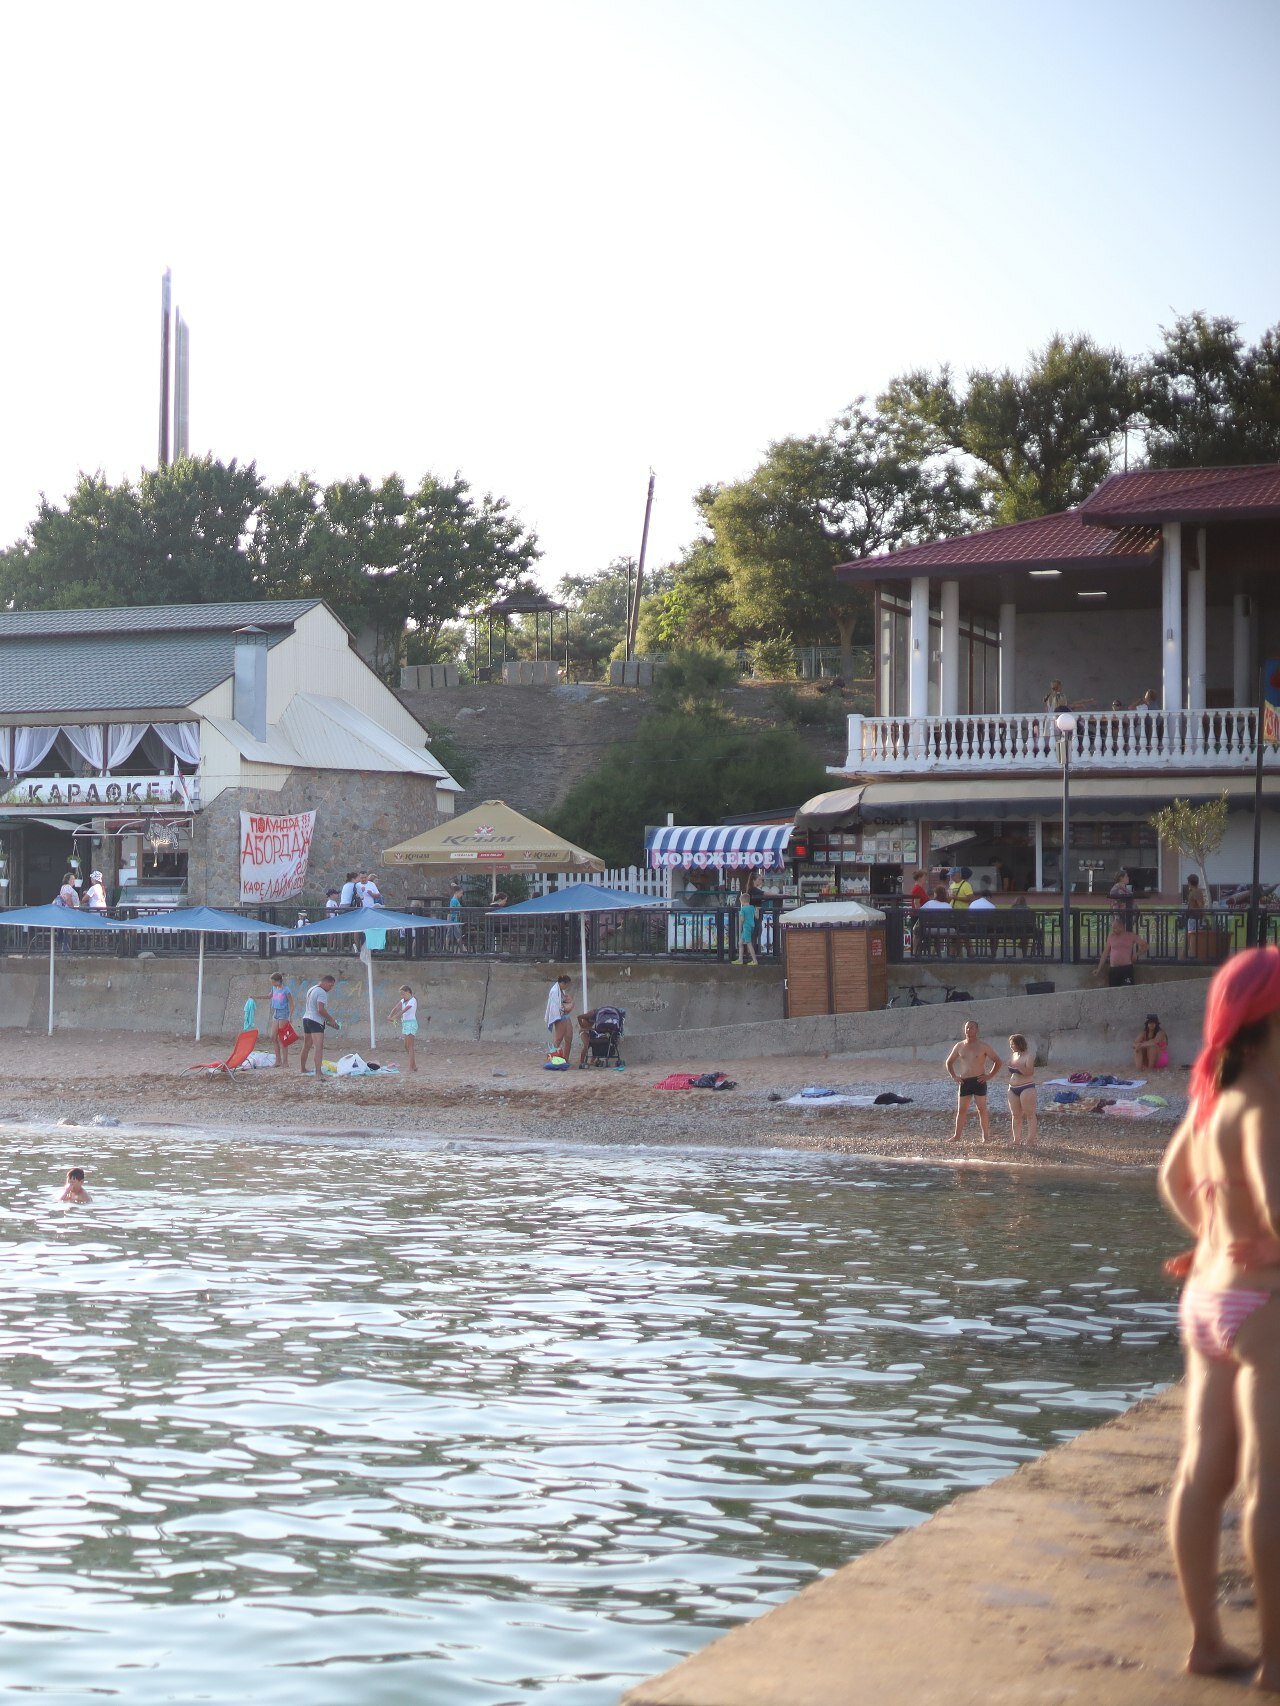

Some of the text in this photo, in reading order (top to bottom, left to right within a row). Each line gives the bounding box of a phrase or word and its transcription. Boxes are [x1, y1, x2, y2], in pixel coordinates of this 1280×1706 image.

[28, 782, 160, 803] КАРАОКЕ
[242, 828, 314, 865] АБОРДАЖ
[655, 851, 776, 866] МОРОЖЕНОЕ
